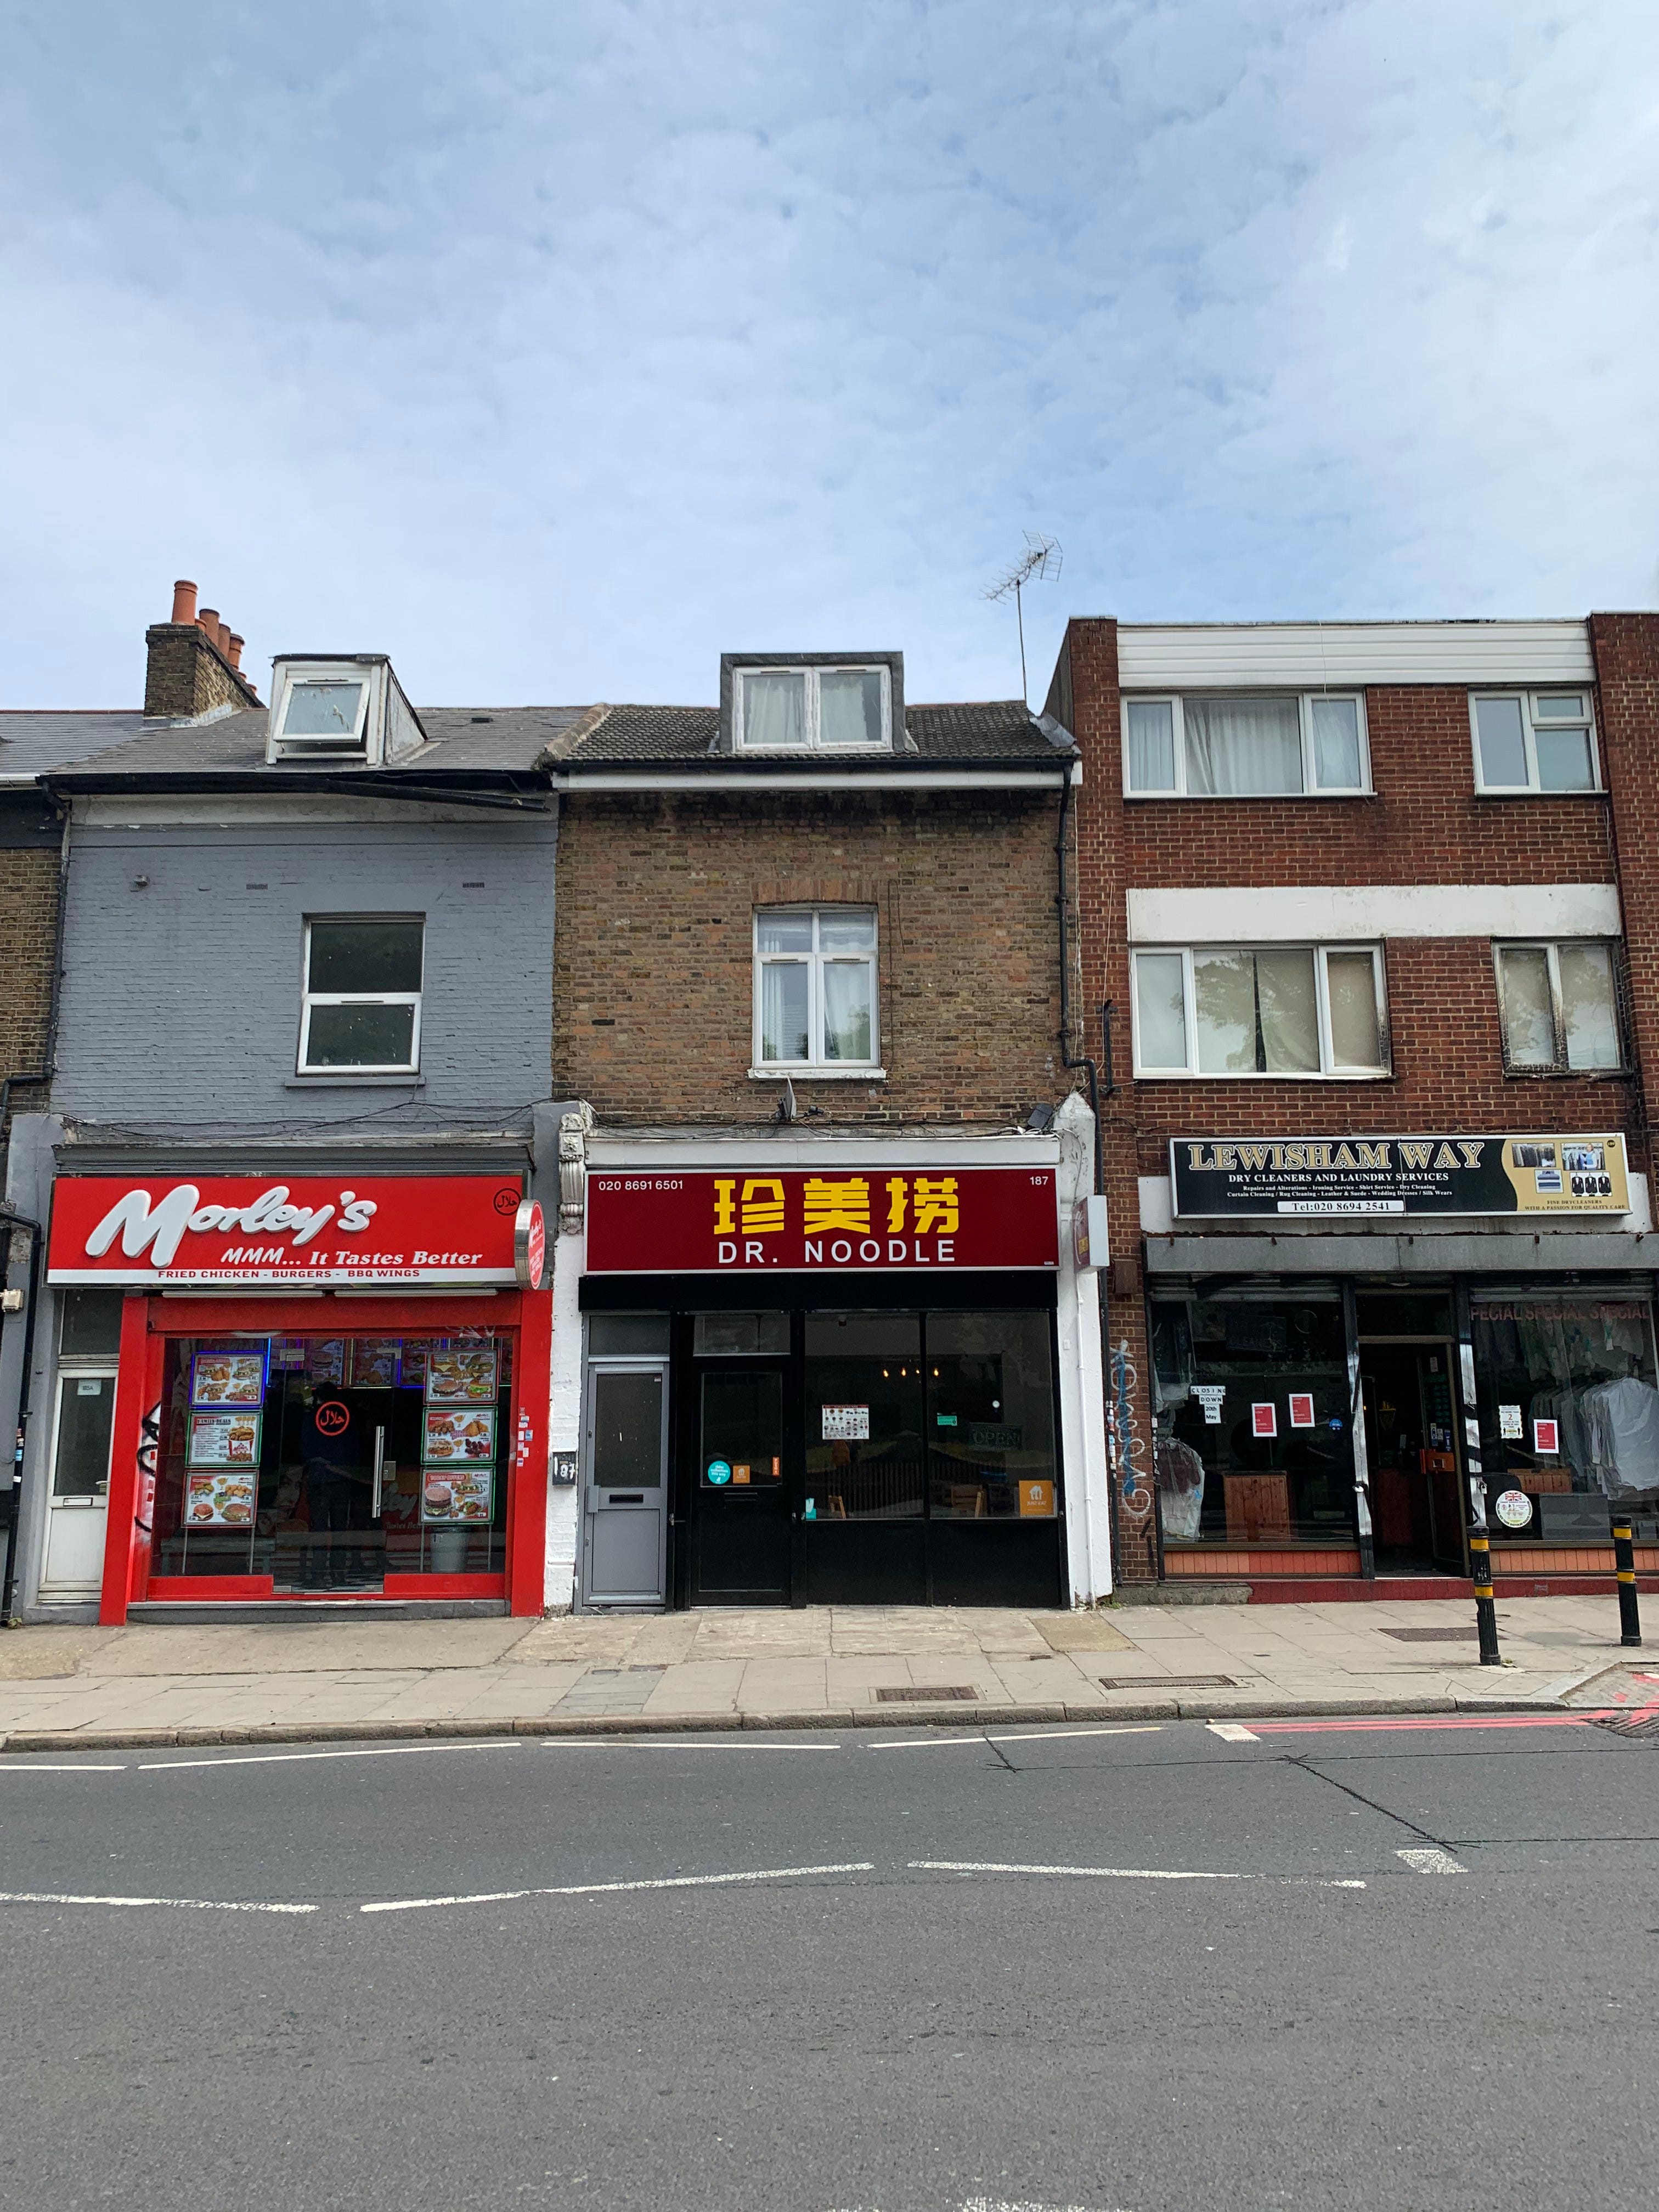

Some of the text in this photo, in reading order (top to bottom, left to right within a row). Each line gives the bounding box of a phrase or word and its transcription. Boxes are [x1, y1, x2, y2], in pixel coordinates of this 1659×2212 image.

[1188, 1142, 1485, 1170] LEWISHAM WAY
[599, 1180, 683, 1190] 020 8691 6501
[1029, 1176, 1048, 1186] 187
[1228, 1174, 1251, 1182] DRY
[1254, 1174, 1311, 1182] CLEANERS
[1314, 1173, 1337, 1182] AND
[1395, 1172, 1449, 1181] SERVICES
[714, 1178, 958, 1234] 珍美捞
[1292, 1202, 1390, 1211] Tel:020 8694 2541
[86, 1184, 377, 1268] Morley's
[221, 1247, 483, 1265] MMM... It Tastes Better
[719, 1240, 955, 1263] DR. NOODLE
[554, 1456, 575, 1480] 187
